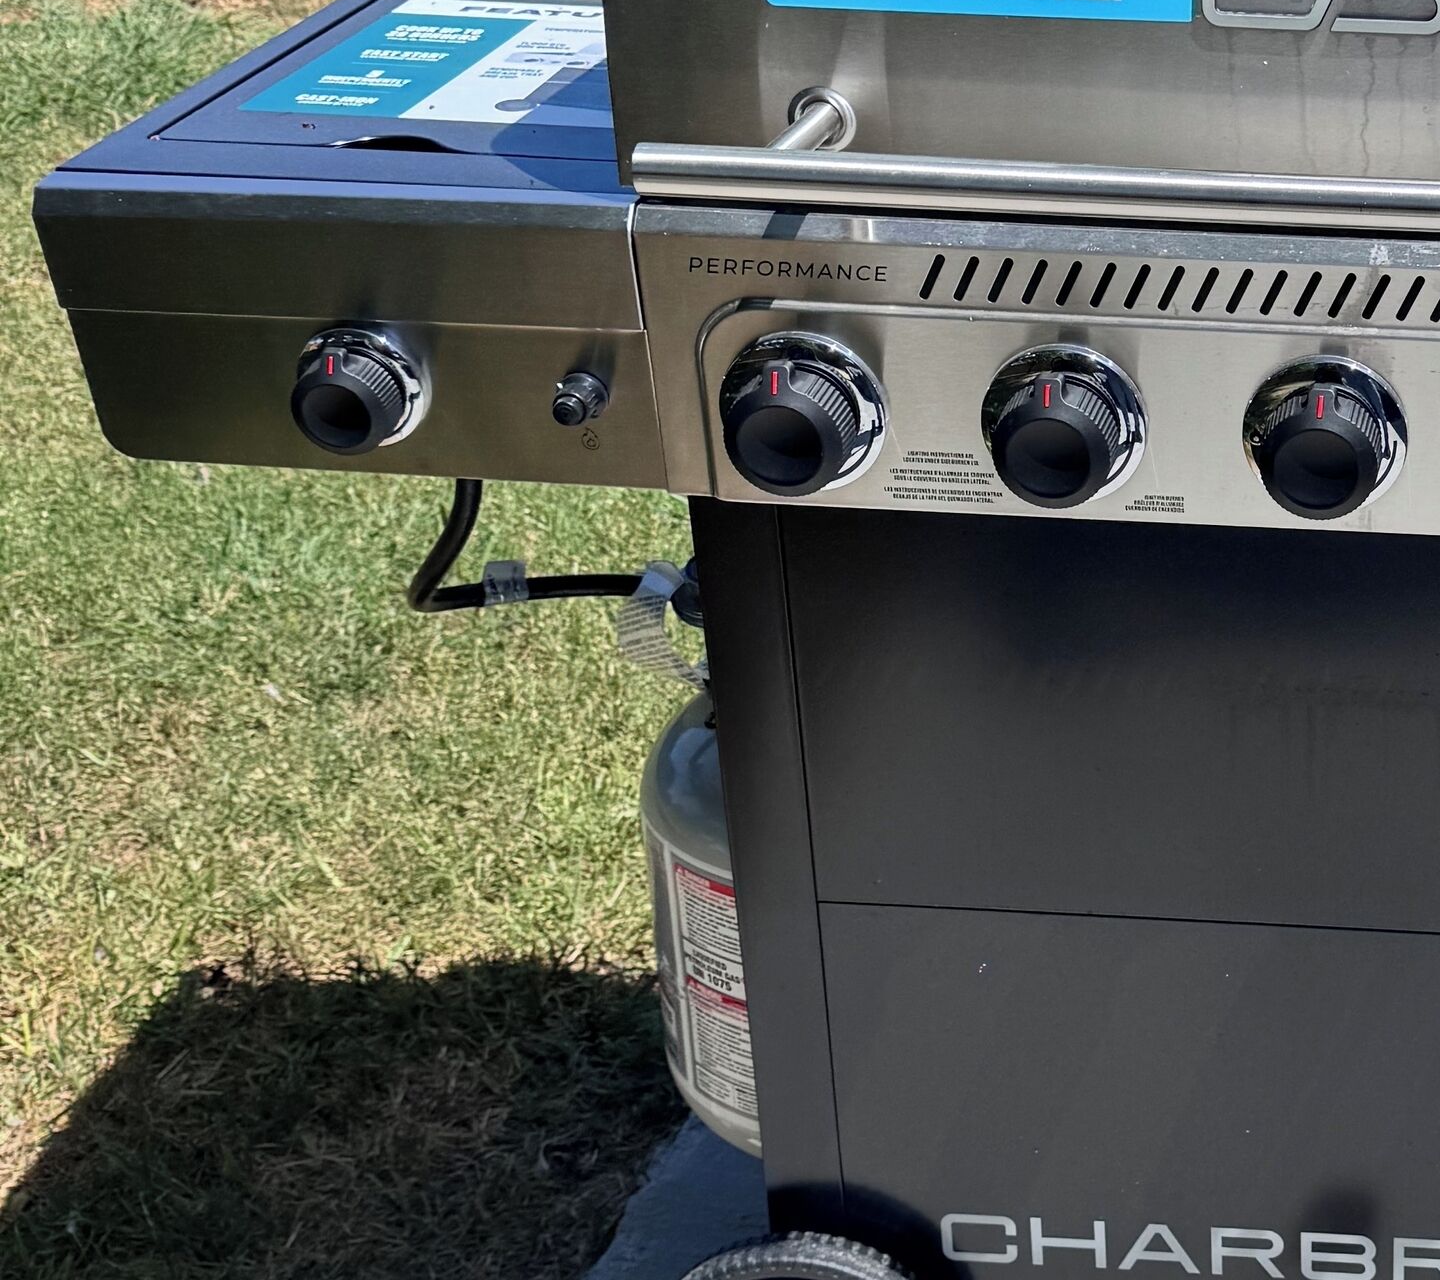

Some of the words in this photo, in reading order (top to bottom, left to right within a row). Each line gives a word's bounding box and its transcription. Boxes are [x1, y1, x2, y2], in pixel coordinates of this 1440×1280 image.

[458, 6, 603, 18] FEATU
[689, 256, 889, 282] PERFORMANCE
[707, 973, 732, 991] 1075
